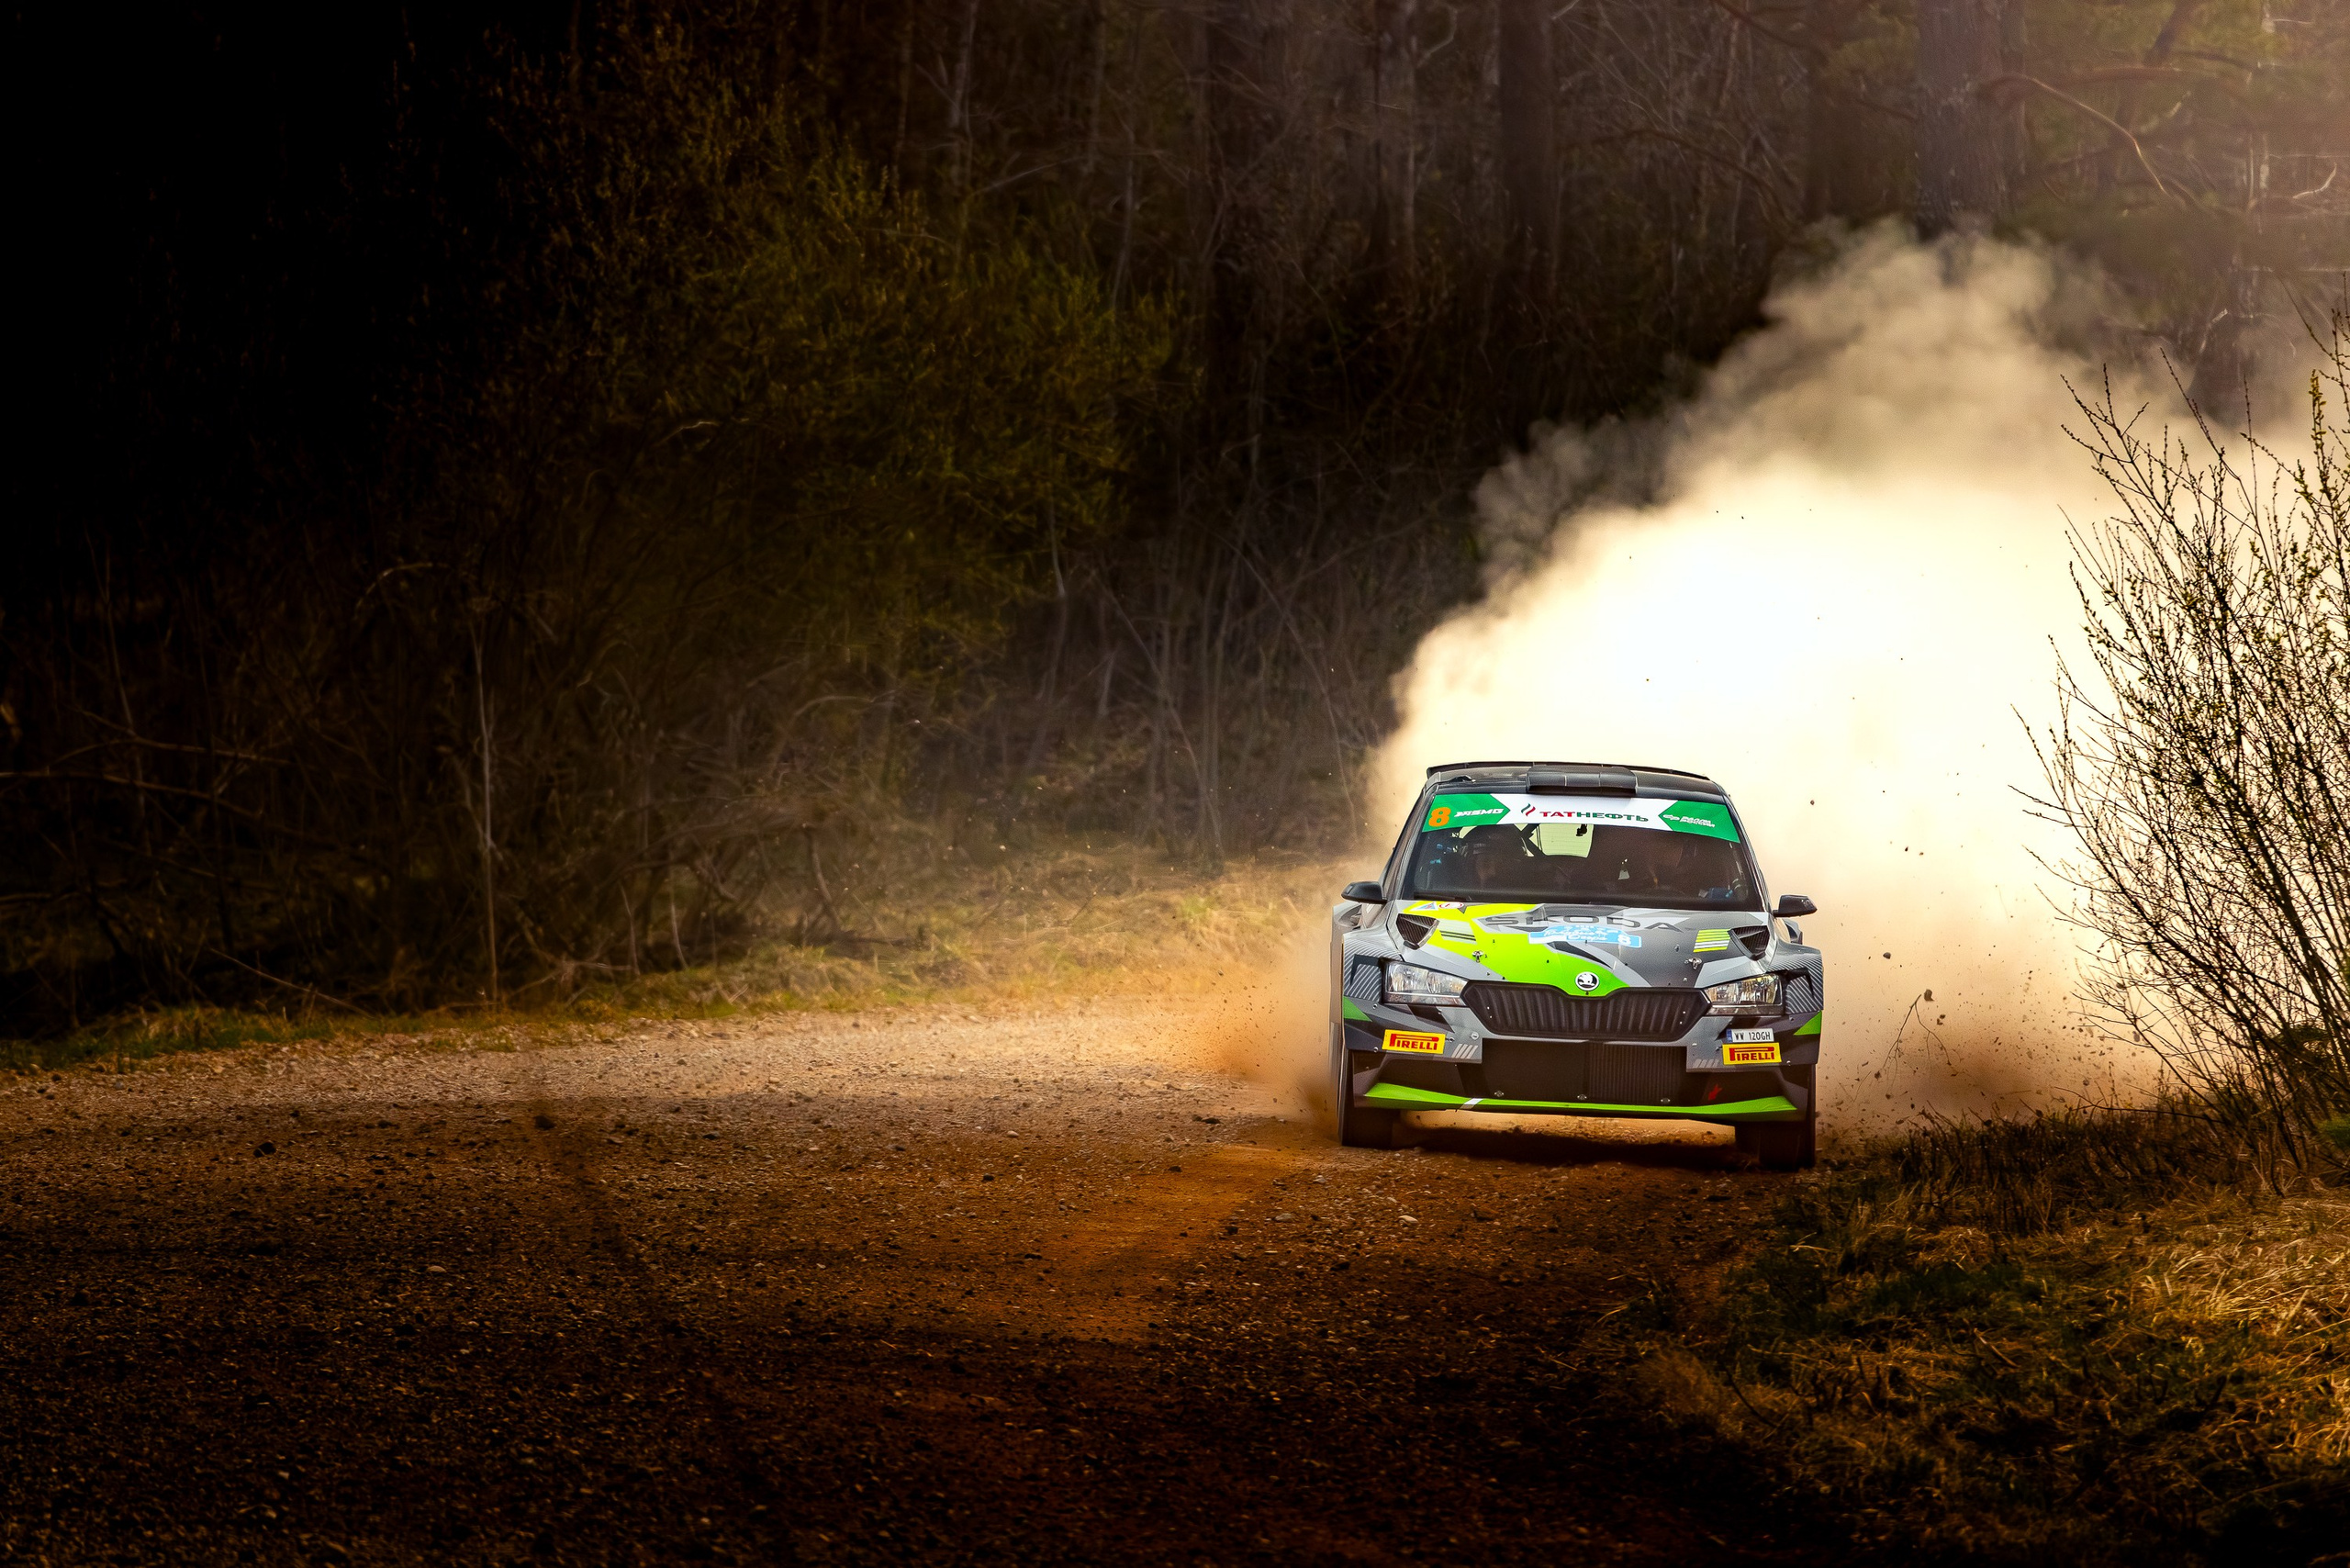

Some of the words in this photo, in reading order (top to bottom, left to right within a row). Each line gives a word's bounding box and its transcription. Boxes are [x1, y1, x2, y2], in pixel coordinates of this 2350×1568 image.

[1428, 807, 1451, 827] 8
[1539, 812, 1649, 823] ТАТНЕФТЬ
[1617, 934, 1632, 946] 8
[1389, 1033, 1439, 1050] PIRELLI
[1748, 1031, 1771, 1041] 120GH
[1729, 1047, 1775, 1061] PIRELLI
